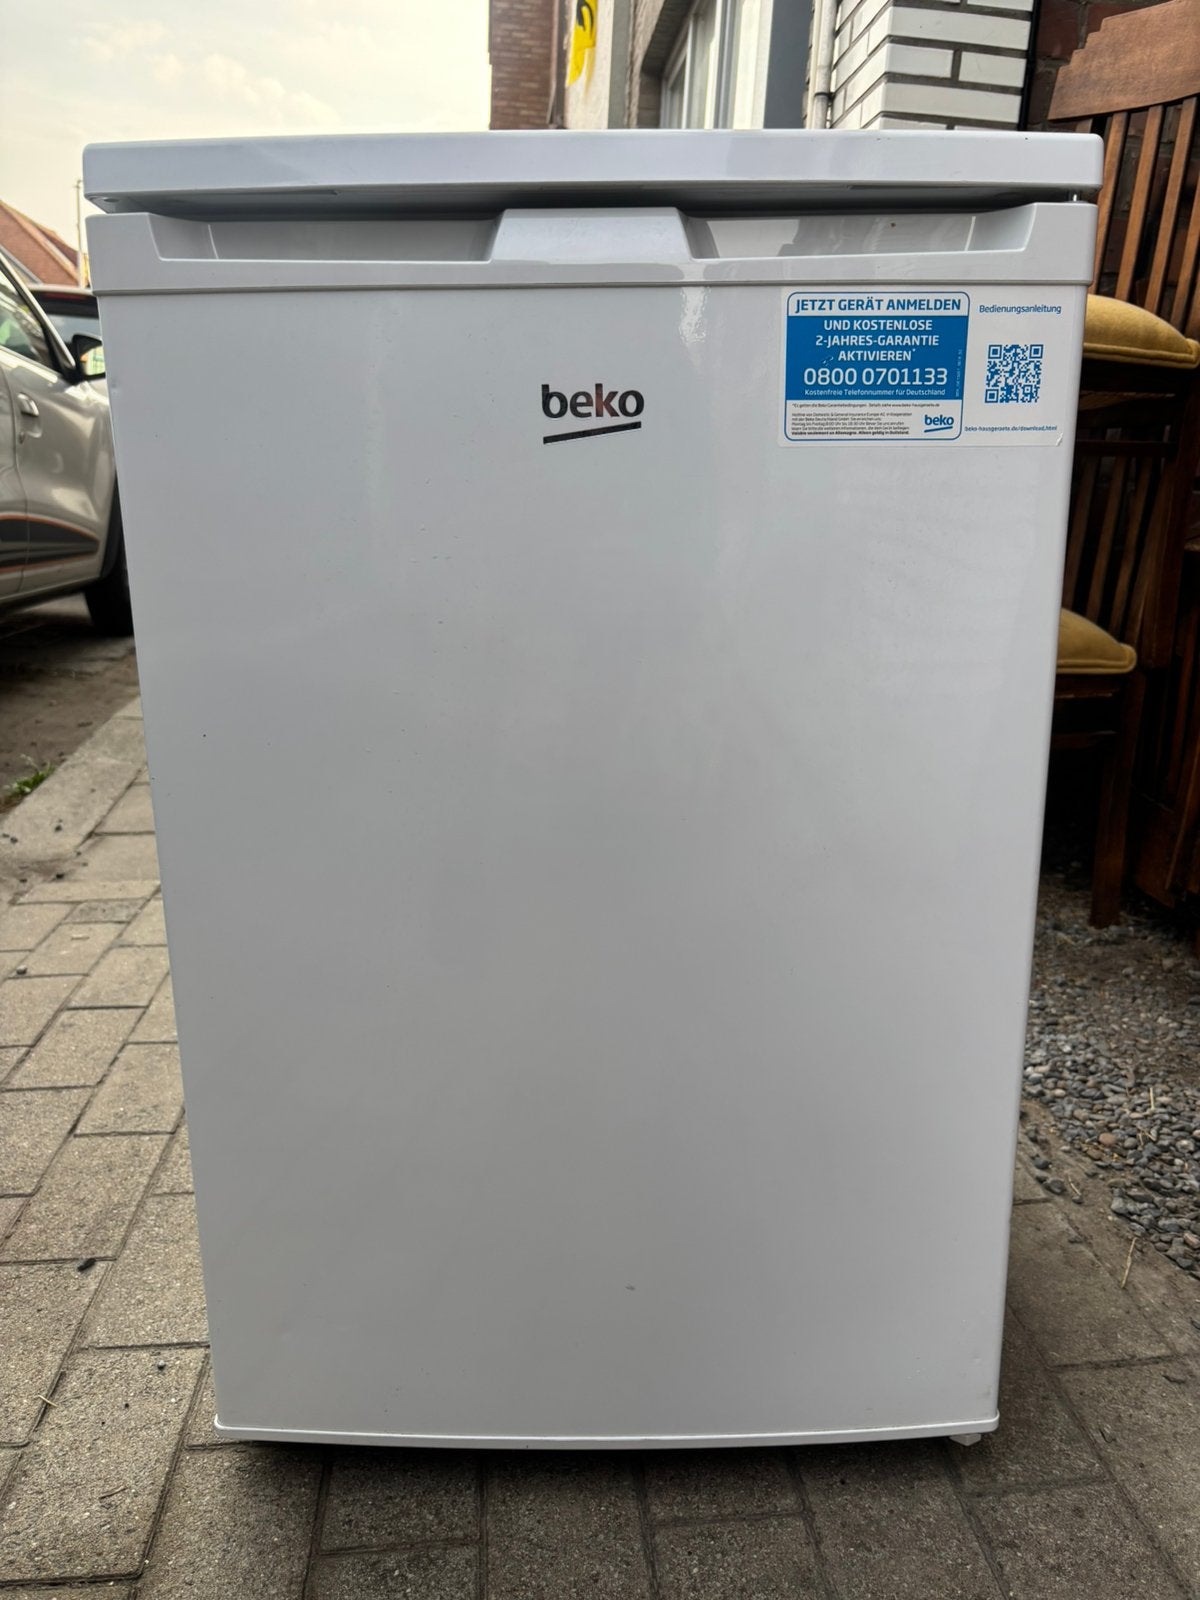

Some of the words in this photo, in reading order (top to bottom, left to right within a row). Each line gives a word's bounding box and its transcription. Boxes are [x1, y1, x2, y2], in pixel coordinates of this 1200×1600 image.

[795, 299, 835, 313] JETZT
[838, 296, 884, 311] GERÄT
[886, 299, 961, 311] ANMELDEN
[979, 304, 1062, 314] Bedienungsanleitung
[824, 319, 850, 331] UND
[853, 319, 933, 331] KOSTENLOSE
[815, 335, 940, 348] 2-JAHRES-GARANTIE
[803, 367, 857, 385] 0800
[862, 367, 948, 385] 0701133
[541, 383, 645, 418] beko
[924, 415, 954, 426] beko
